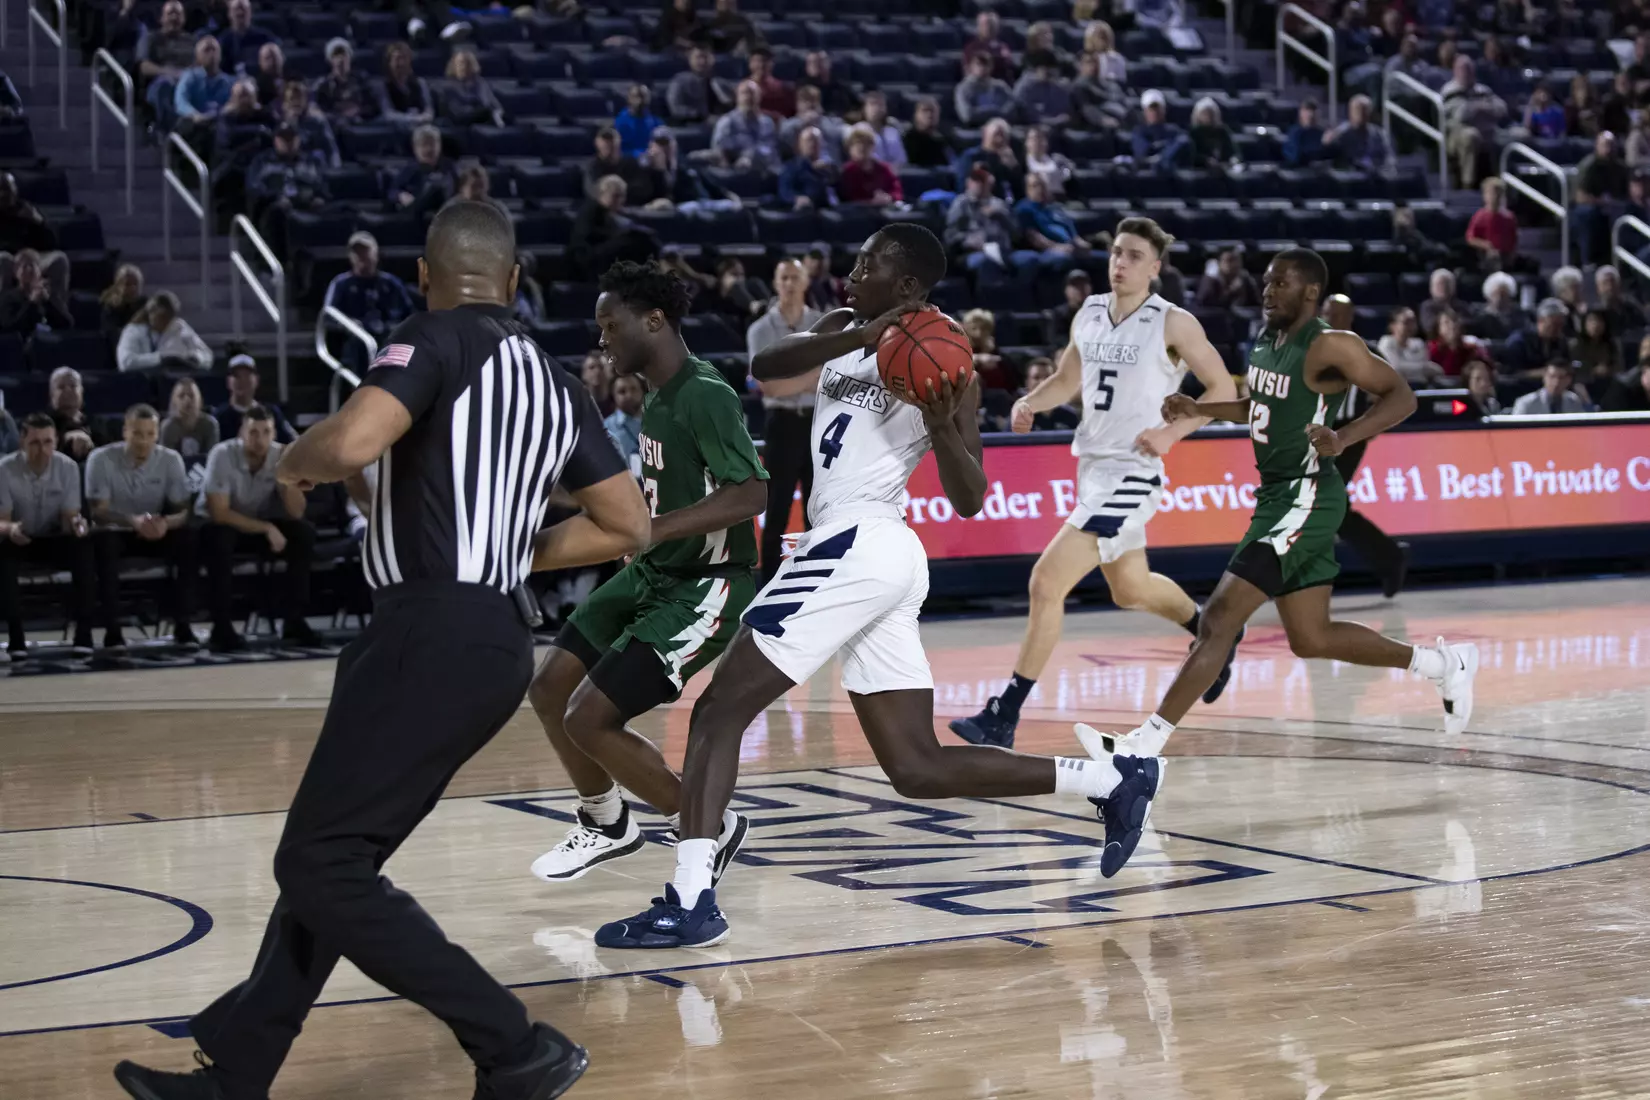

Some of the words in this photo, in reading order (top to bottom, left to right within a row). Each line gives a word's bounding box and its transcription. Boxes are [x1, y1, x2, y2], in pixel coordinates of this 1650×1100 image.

[1083, 342, 1140, 365] LANCERS
[820, 367, 893, 415] LANCERS
[1094, 368, 1118, 411] 5
[819, 412, 853, 470] 4
[1157, 472, 1261, 513] Servic
[1384, 465, 1428, 502] #1
[1437, 463, 1505, 501] Best
[1510, 459, 1621, 497] Private
